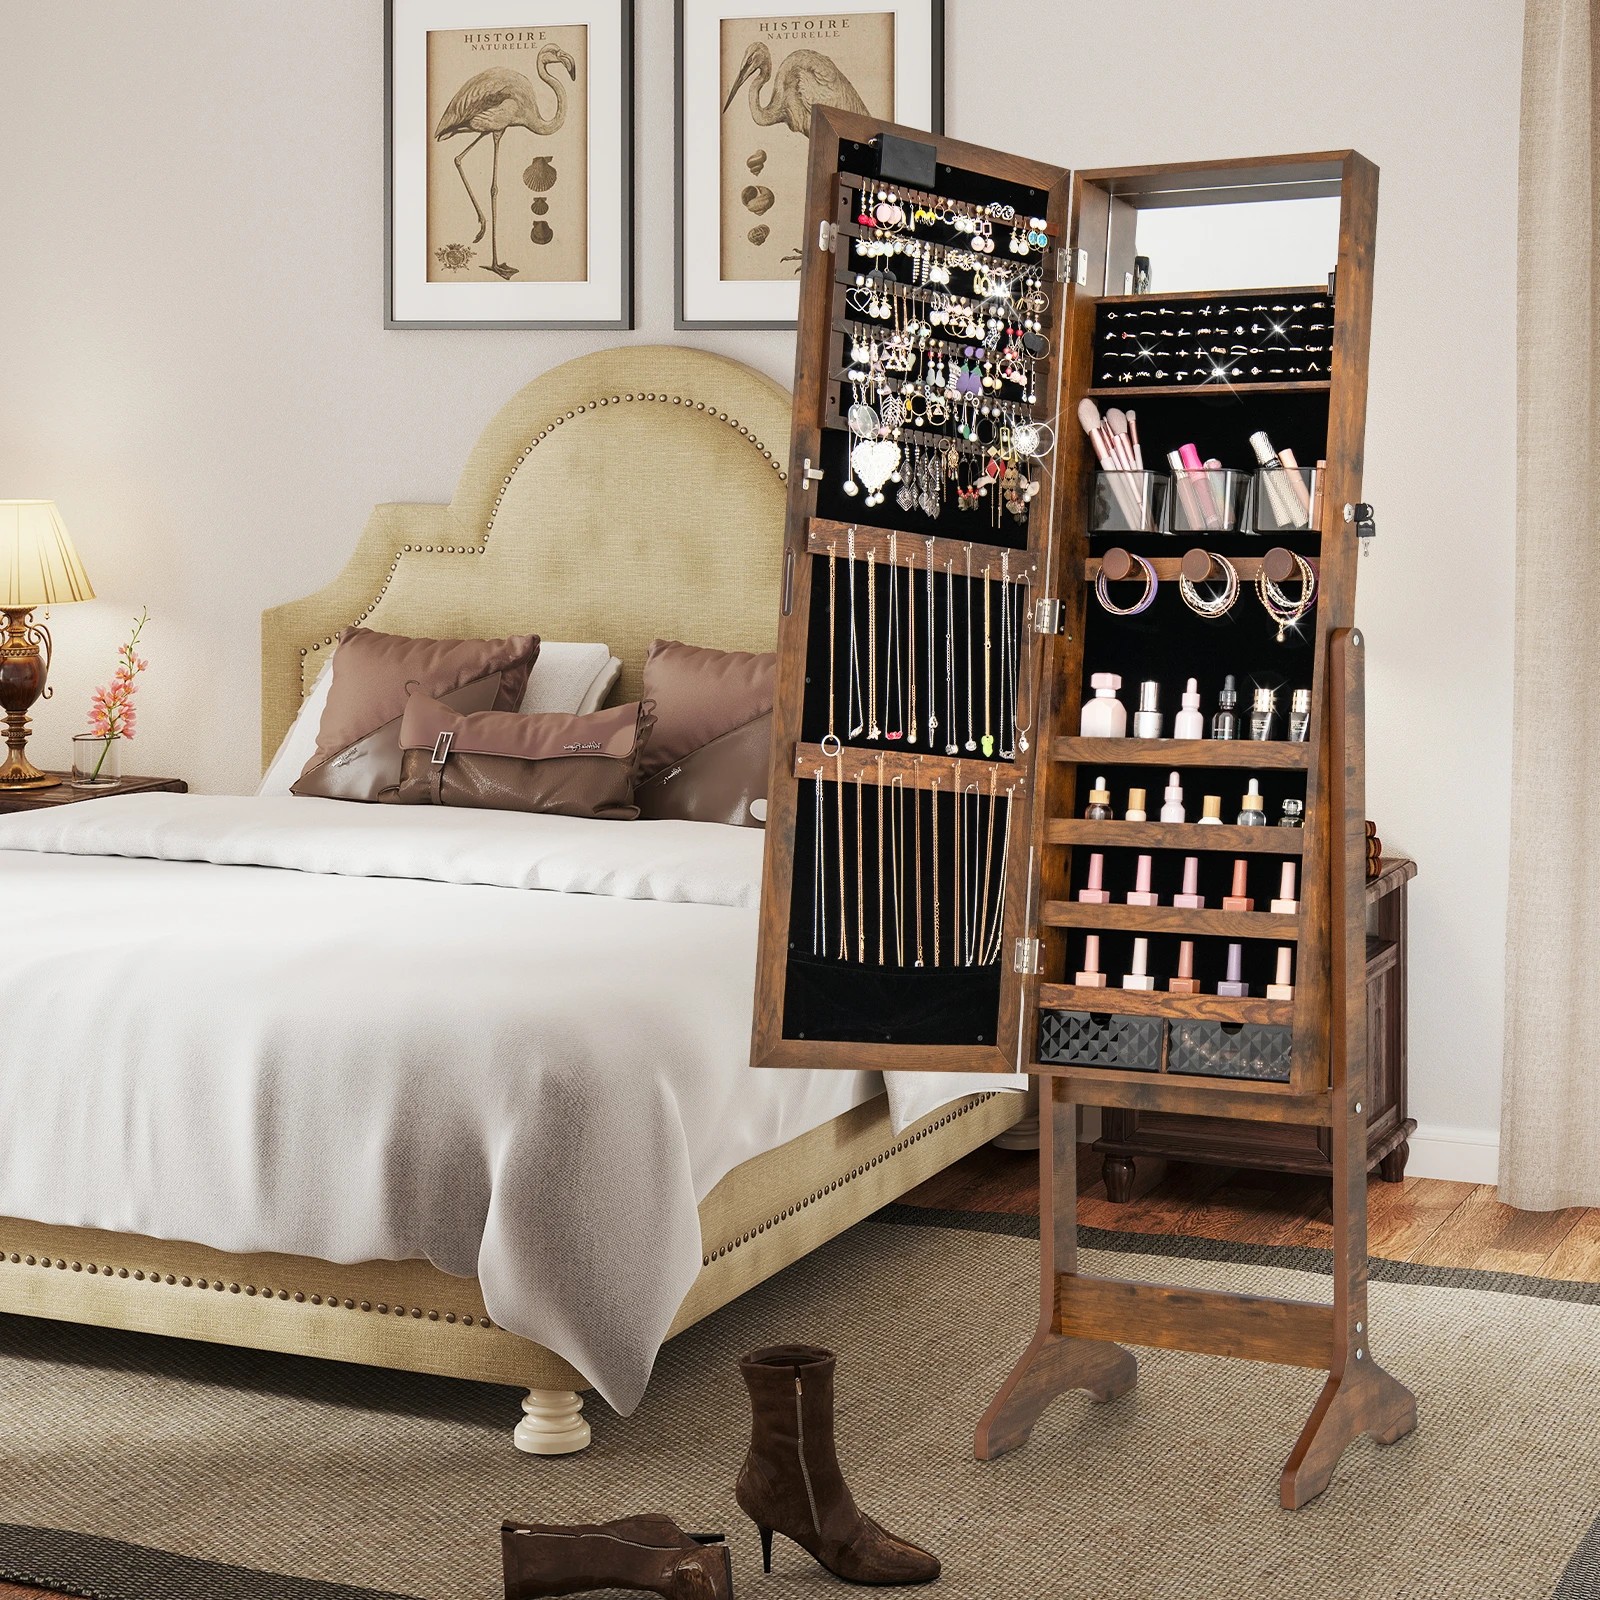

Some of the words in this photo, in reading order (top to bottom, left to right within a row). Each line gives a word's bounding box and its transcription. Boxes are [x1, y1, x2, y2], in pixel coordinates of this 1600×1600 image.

[759, 19, 850, 32] HISTOIRE
[464, 32, 546, 43] HISTOIRE
[767, 31, 840, 40] NATURELLE
[471, 42, 538, 51] NATURELLE
